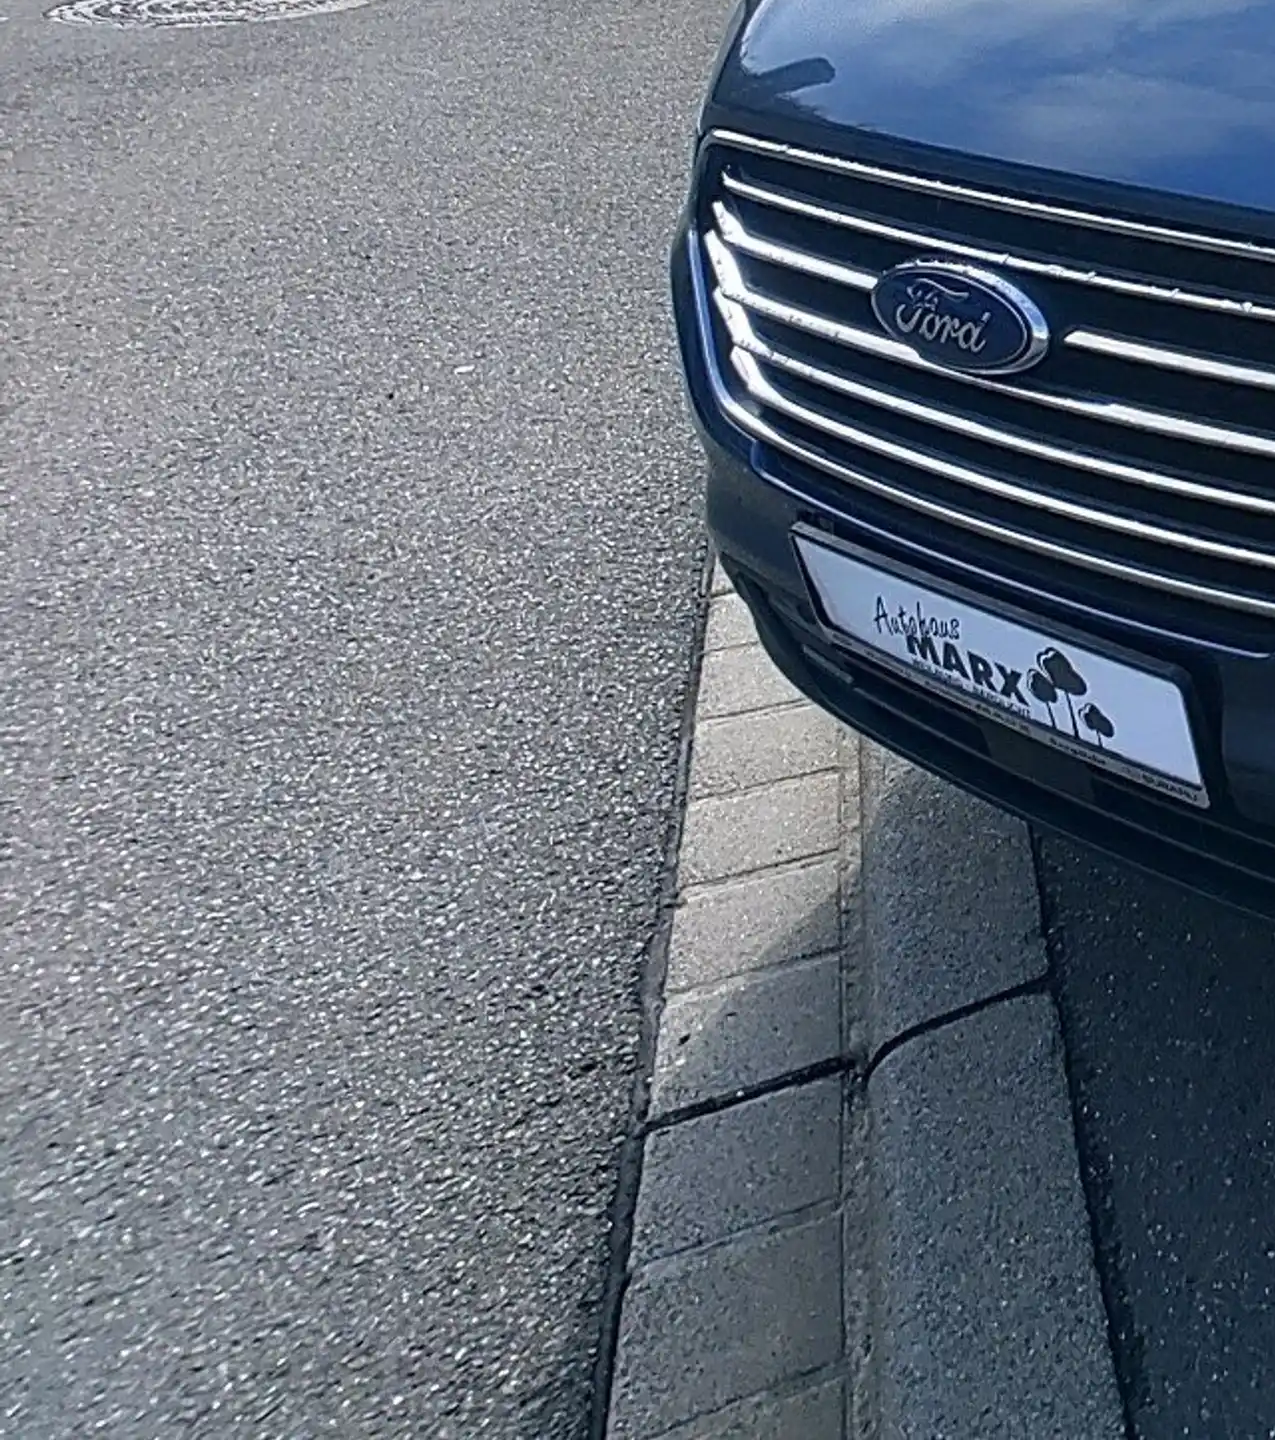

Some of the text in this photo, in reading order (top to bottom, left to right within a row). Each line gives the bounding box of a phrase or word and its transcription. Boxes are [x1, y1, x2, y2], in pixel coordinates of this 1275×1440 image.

[896, 277, 991, 353] Ford
[873, 594, 961, 640] Autohaus
[905, 633, 1030, 707] MARX
